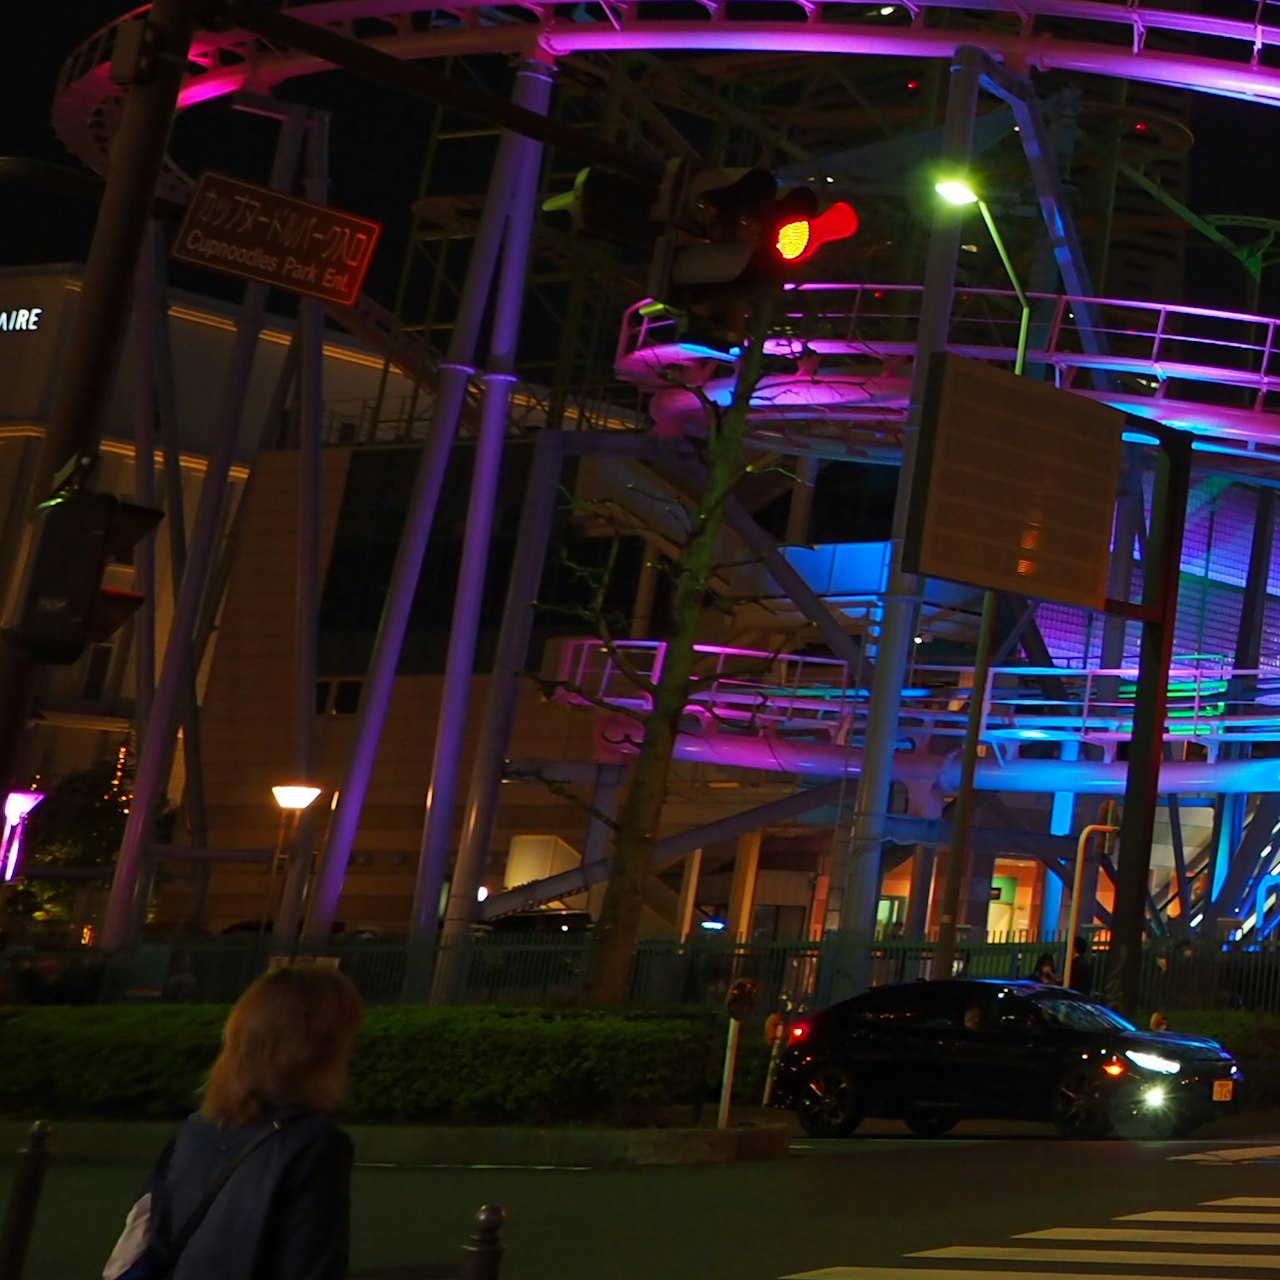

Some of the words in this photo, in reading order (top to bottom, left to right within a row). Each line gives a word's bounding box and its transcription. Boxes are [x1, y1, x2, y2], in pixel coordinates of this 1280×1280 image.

[186, 228, 279, 272] Cupnoodles
[281, 255, 318, 285] Park
[196, 191, 368, 266] カップヌードルパーク入口
